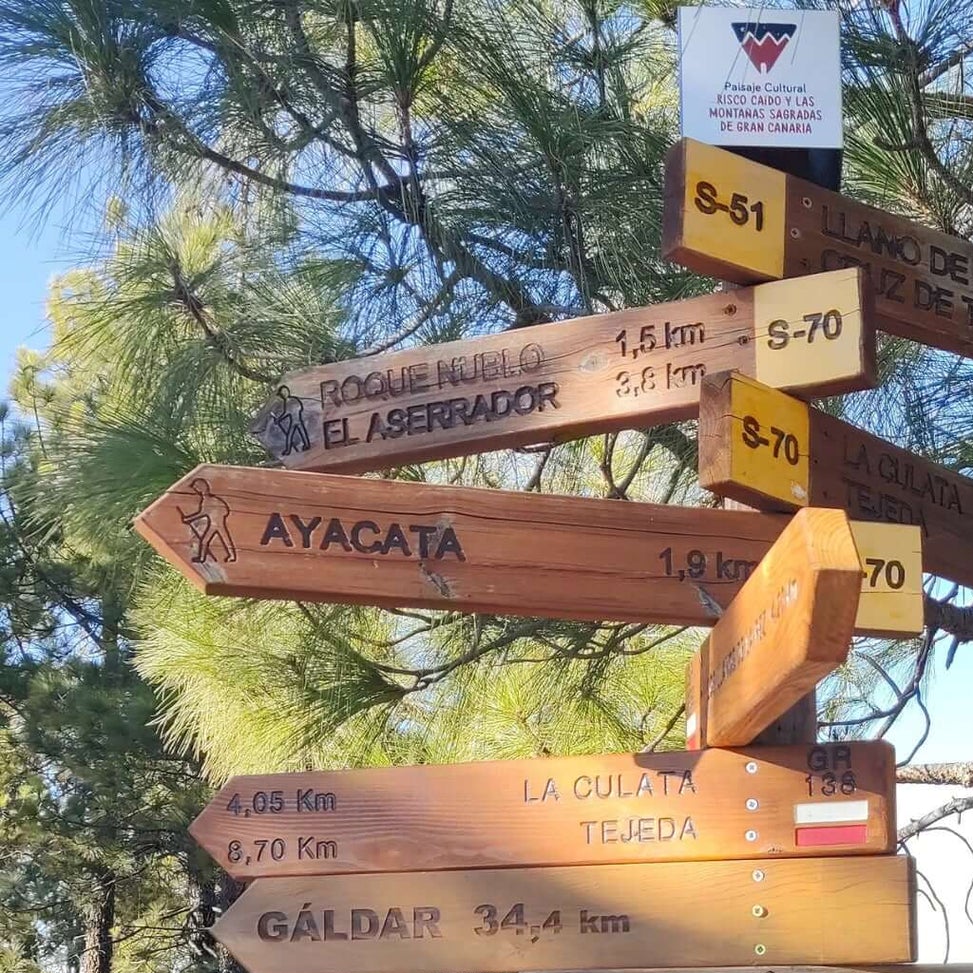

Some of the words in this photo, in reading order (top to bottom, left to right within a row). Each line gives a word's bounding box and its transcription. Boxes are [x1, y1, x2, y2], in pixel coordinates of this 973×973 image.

[716, 94, 747, 106] RISCO
[785, 96, 792, 107] Y
[795, 96, 815, 107] LAS
[724, 82, 761, 94] Paisaje
[764, 82, 807, 94] Cultural
[720, 121, 733, 132] DE
[736, 121, 764, 133] GRAN
[768, 122, 812, 134] CANARIA
[769, 109, 823, 121] SAGRADAS
[694, 179, 764, 232] S-51
[821, 204, 922, 267] LLANO
[929, 244, 970, 286] DE
[914, 278, 954, 321] DE
[767, 308, 844, 351] S-70
[318, 361, 431, 409] ROQUE
[436, 342, 546, 388] NUBLO
[615, 325, 658, 359] 1,5
[665, 320, 707, 350] km
[323, 415, 361, 450] EL
[365, 381, 562, 444] ASERRADOR
[615, 369, 658, 400] 3,8
[666, 361, 707, 390] km
[741, 415, 800, 467] S-70
[843, 436, 872, 474] LA
[877, 454, 965, 515] CULATA
[260, 511, 468, 563] AYACATA
[658, 546, 706, 581] 1,9
[716, 550, 760, 580] km
[861, 557, 906, 590] -70
[806, 745, 852, 772] GR
[226, 789, 286, 818] 4,05
[296, 788, 337, 813] Km
[522, 777, 565, 804] LA
[573, 768, 698, 800] CULATA
[226, 837, 287, 865] 8,70
[298, 837, 339, 862] Km
[579, 815, 698, 847] TEJEDA
[257, 900, 442, 945] GÁLDAR
[472, 903, 564, 943] 34,4
[579, 906, 631, 936] km
